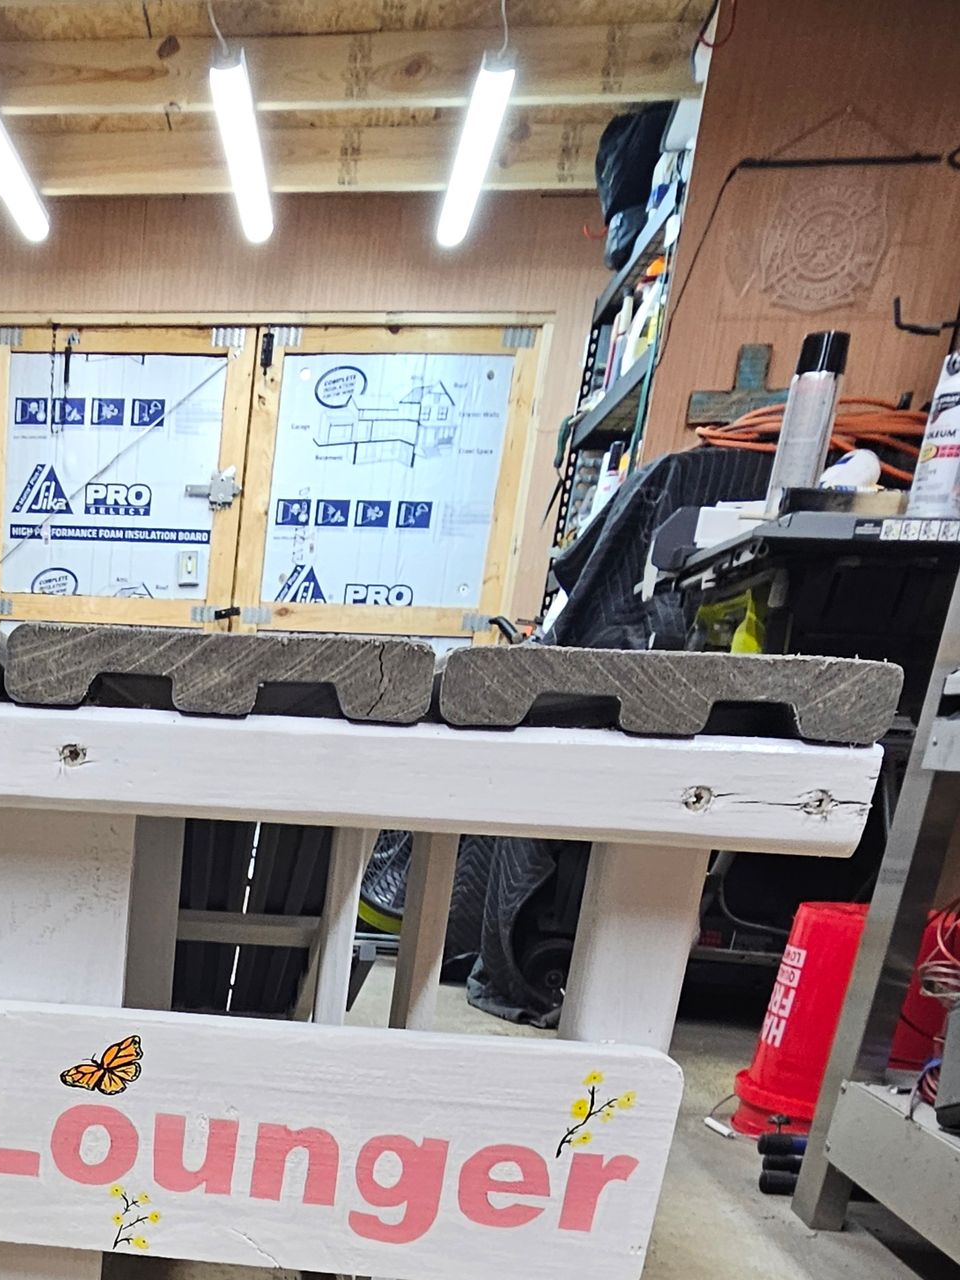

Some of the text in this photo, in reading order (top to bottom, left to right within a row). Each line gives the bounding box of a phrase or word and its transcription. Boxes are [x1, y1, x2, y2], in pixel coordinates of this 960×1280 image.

[31, 480, 67, 510] Sika
[85, 483, 152, 507] PRO
[89, 507, 146, 516] SELECT
[11, 526, 208, 542] HIGH PFORMANCE FOAM INSULATION BOARD
[345, 584, 413, 606] PRO
